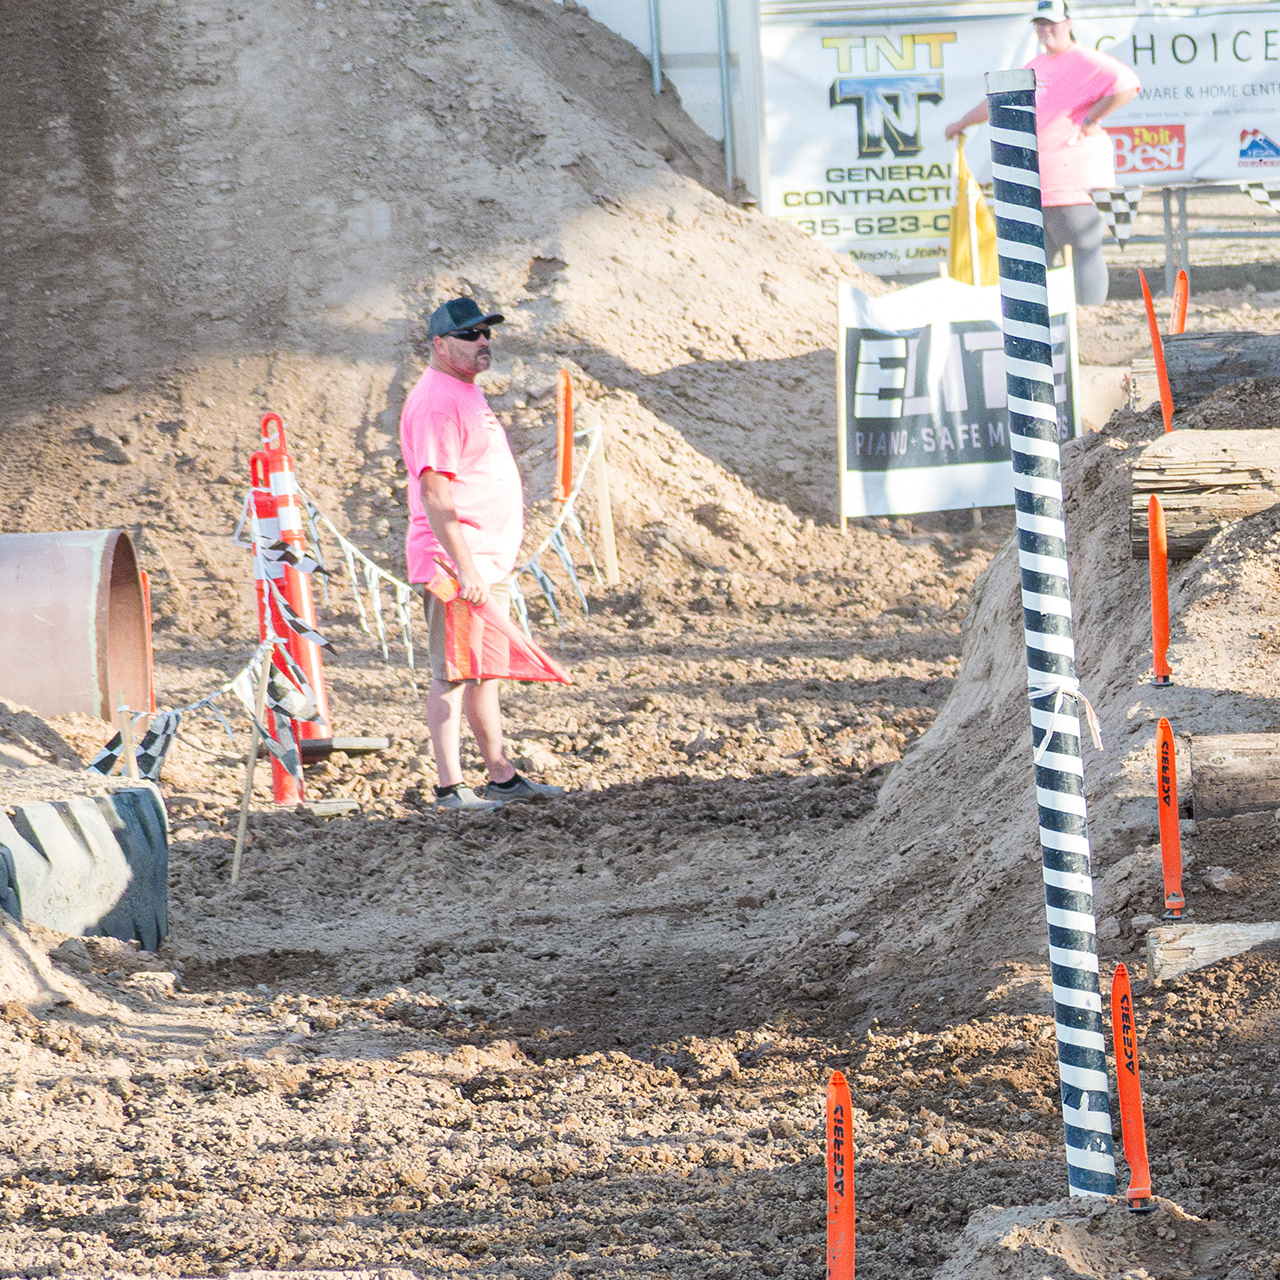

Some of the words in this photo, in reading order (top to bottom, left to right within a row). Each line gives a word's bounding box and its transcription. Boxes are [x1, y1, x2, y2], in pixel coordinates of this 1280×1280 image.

[822, 32, 957, 73] TNT
[1140, 87, 1180, 101] WARE
[1185, 86, 1195, 100] &
[1200, 84, 1238, 99] HOME
[1114, 135, 1184, 173] Best
[797, 214, 951, 237] 35-623-0
[905, 247, 947, 260] Utah
[855, 430, 908, 456] PIANO
[921, 422, 980, 453] SAFE
[1161, 740, 1172, 808] ACERBIS
[1119, 993, 1136, 1076] ACERBIS
[833, 1104, 845, 1197] ACERBIS
